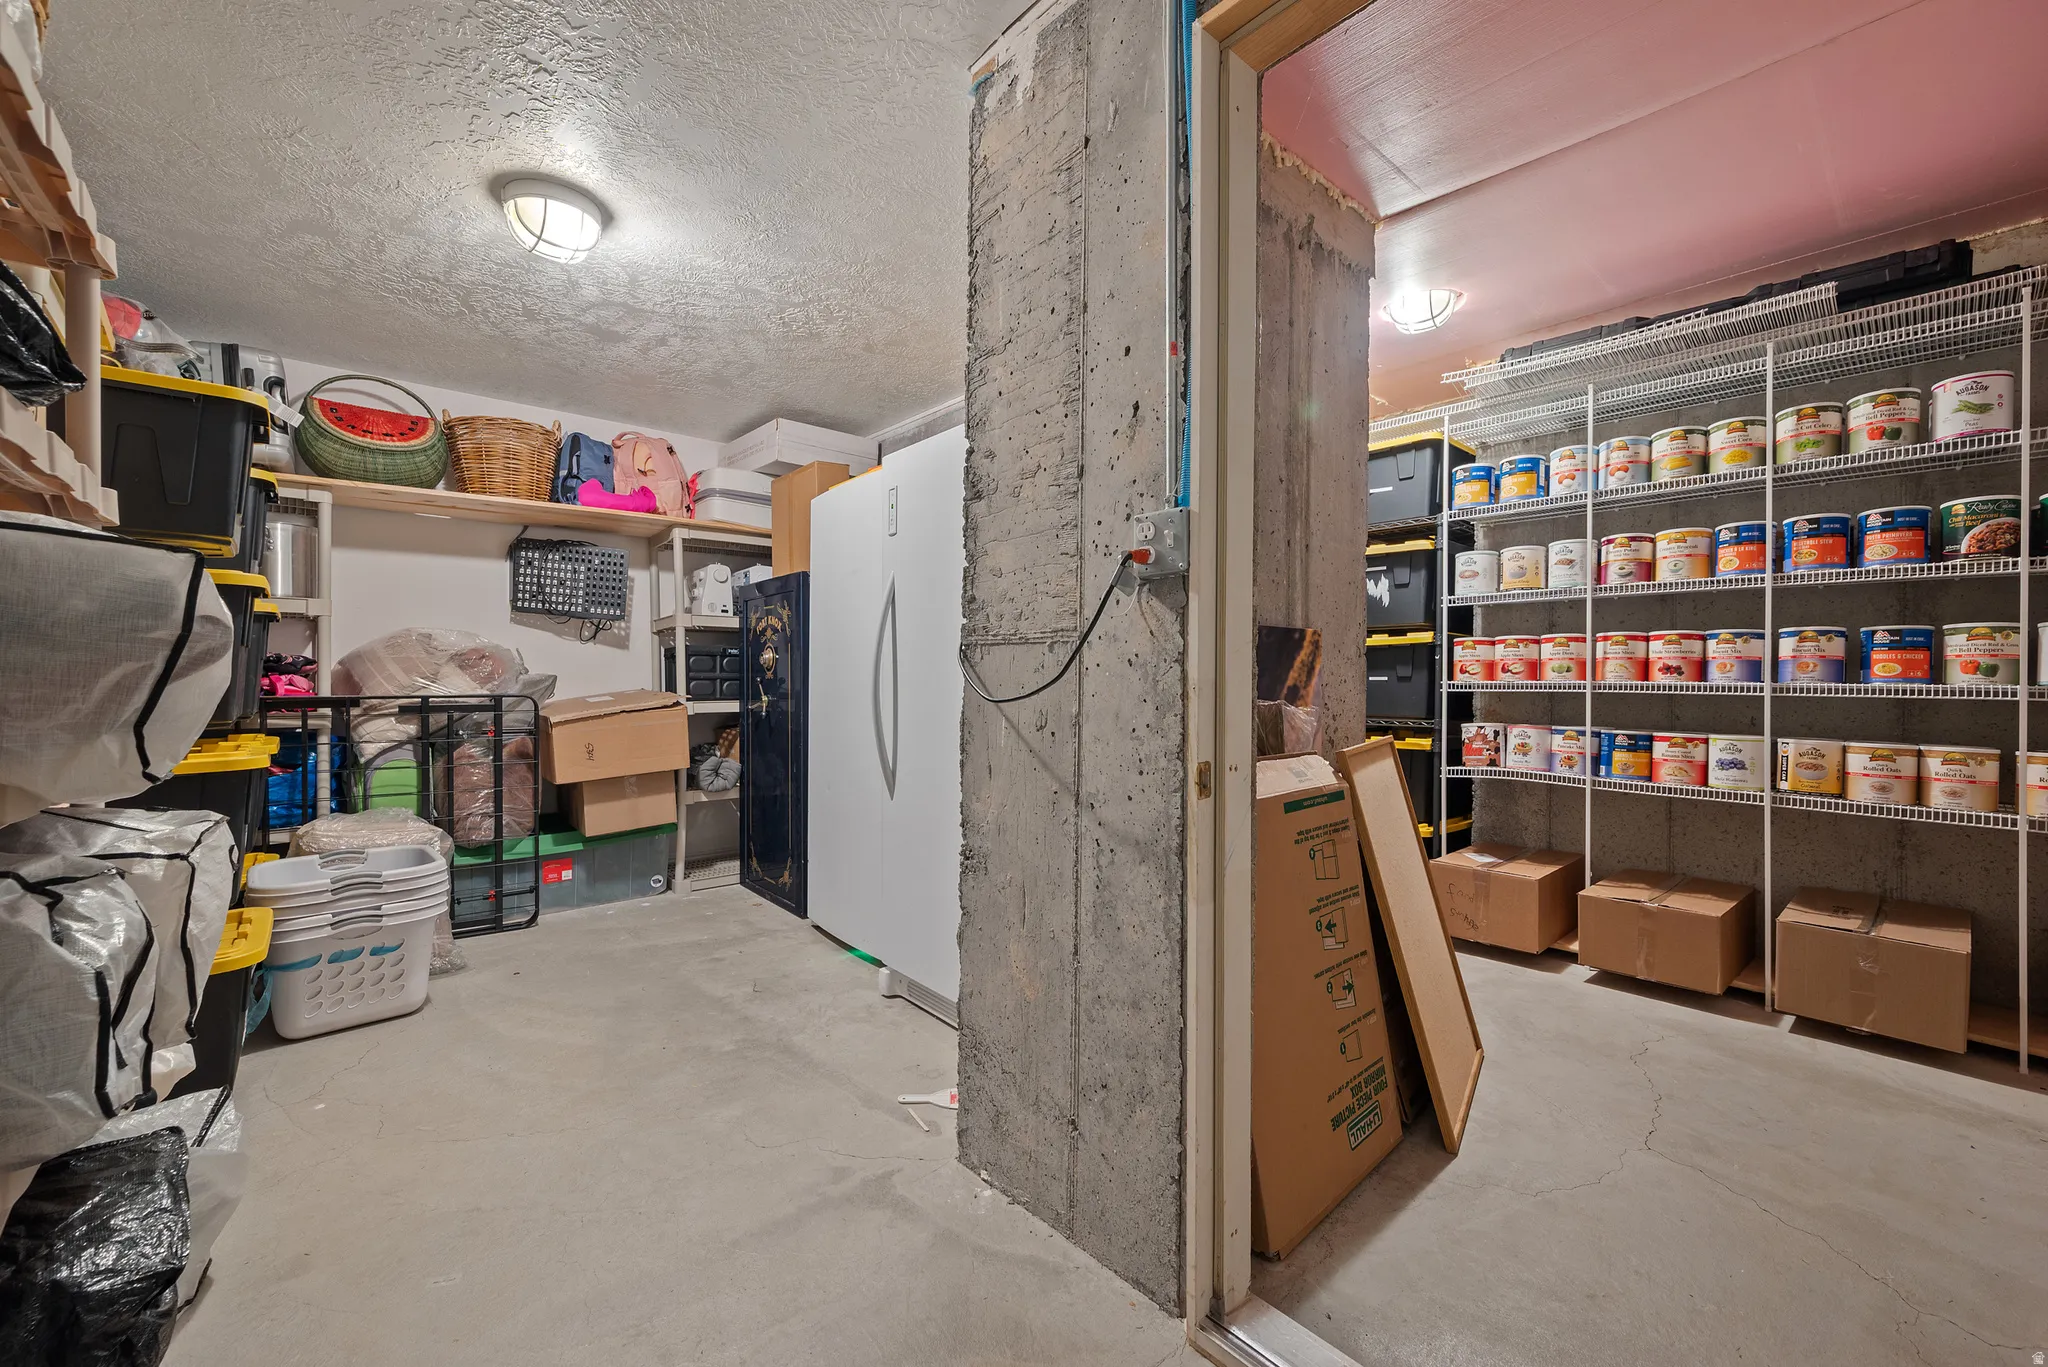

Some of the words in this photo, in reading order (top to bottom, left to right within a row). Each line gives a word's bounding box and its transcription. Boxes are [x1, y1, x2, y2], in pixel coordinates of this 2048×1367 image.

[1956, 384, 1990, 396] AUGASON
[1963, 513, 1999, 521] Macaroni
[756, 616, 768, 635] FORT
[768, 616, 782, 632] KNOX
[1718, 746, 1743, 754] AUGASON
[1303, 796, 1328, 805] uhaul.com
[1363, 1064, 1386, 1089] MIRROR
[1350, 1081, 1363, 1100] BOX
[1373, 1076, 1388, 1097] FOUR
[1356, 1088, 1373, 1111] PIECE
[1330, 1102, 1356, 1132] PICTURE
[1350, 1110, 1381, 1145] U-HAUL
